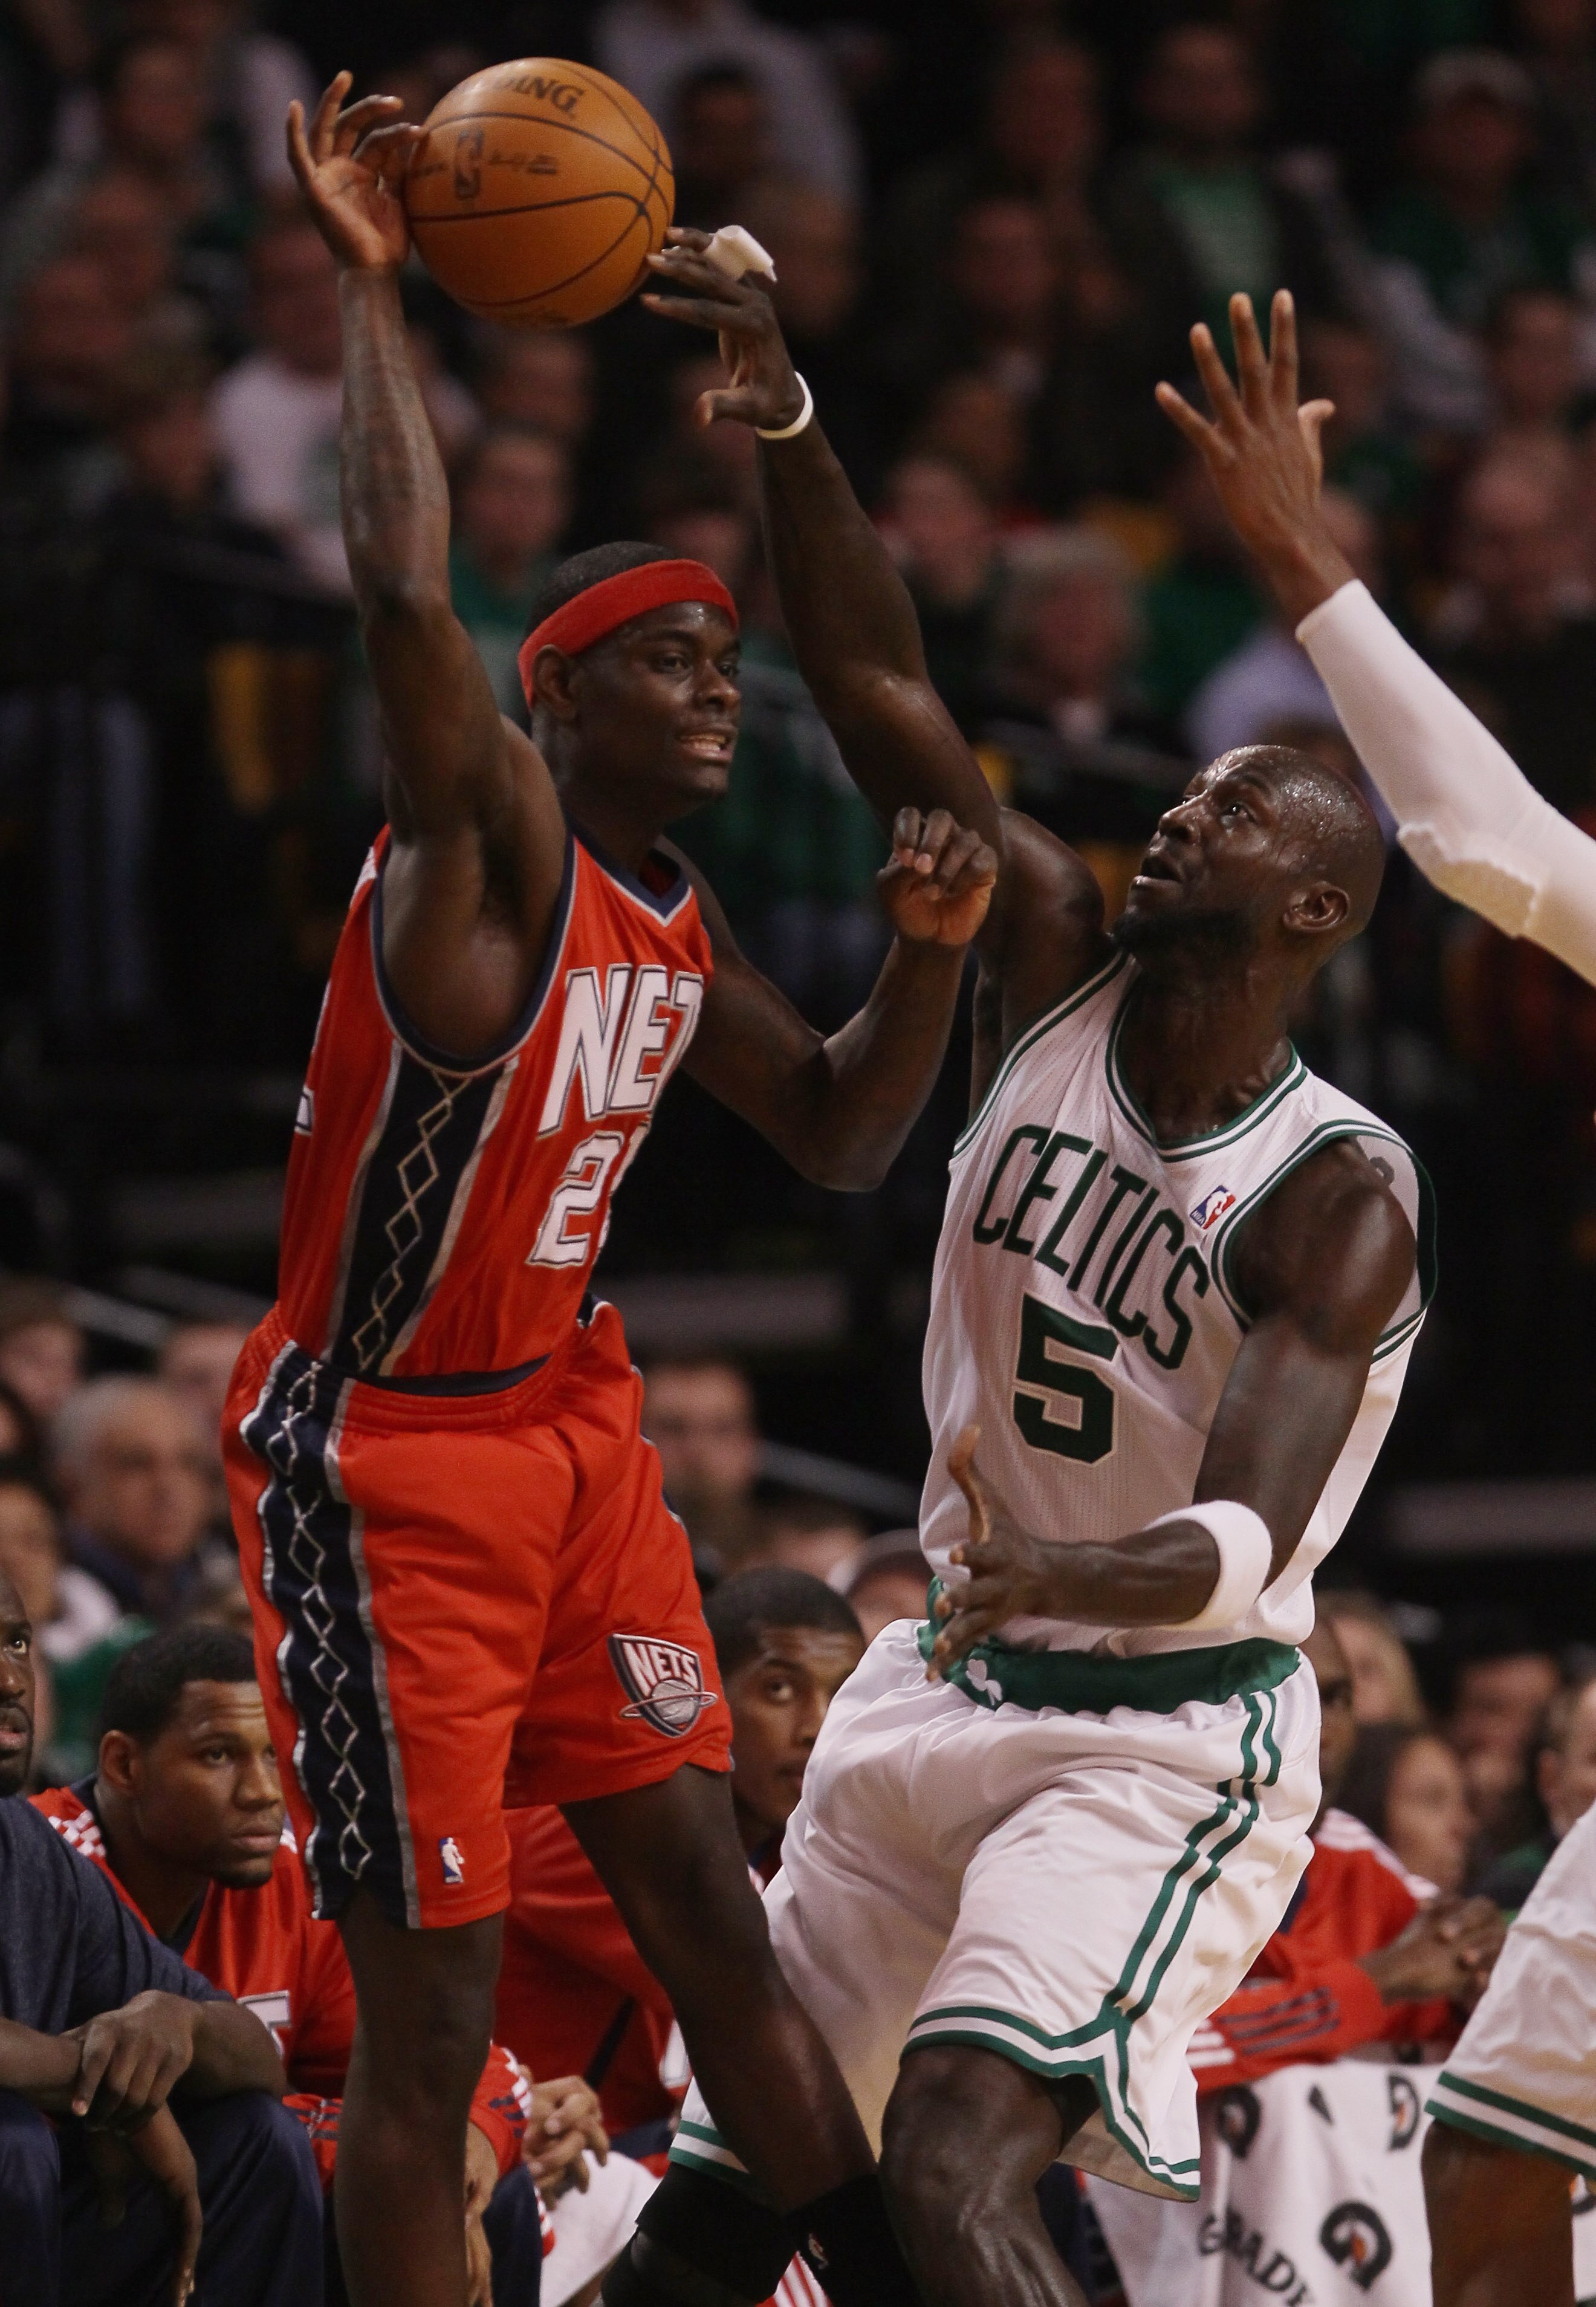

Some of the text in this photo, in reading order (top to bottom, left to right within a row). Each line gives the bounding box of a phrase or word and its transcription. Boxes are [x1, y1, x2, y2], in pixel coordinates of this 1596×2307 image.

[972, 1124, 1209, 1370] CELTICS
[1013, 1293, 1120, 1465] 5
[621, 1641, 698, 1697] NETS
